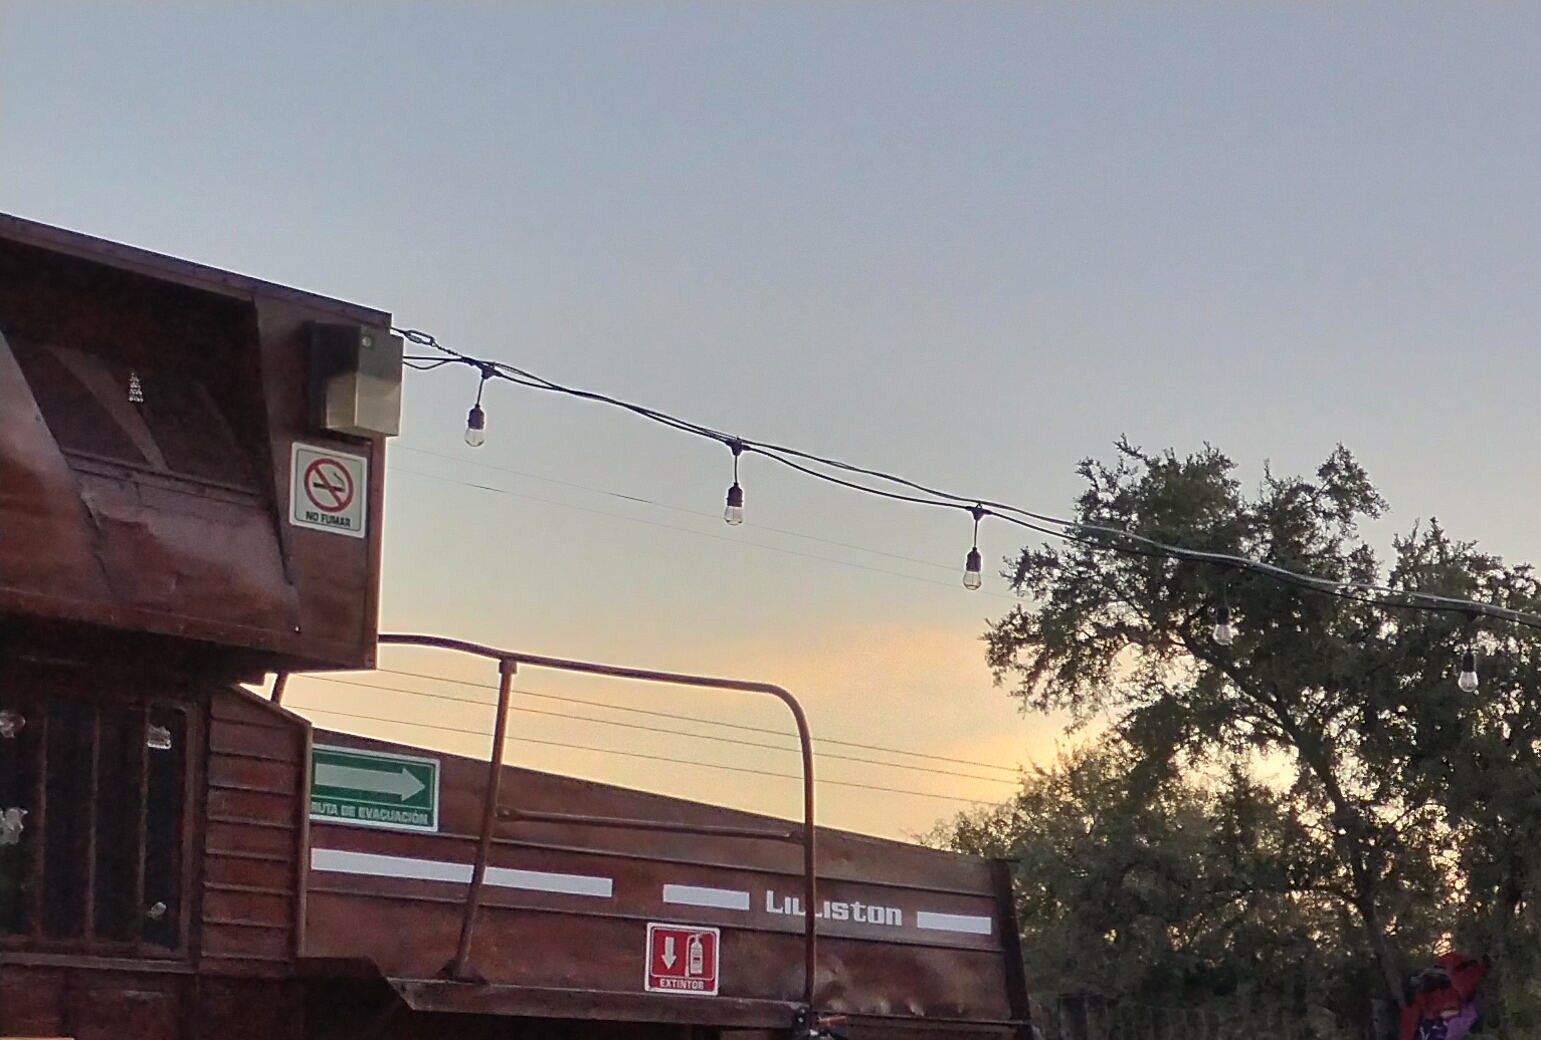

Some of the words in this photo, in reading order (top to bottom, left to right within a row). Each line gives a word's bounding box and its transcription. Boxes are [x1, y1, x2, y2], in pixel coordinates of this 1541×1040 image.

[306, 511, 319, 521] NO
[321, 514, 351, 527] FUMAR
[311, 801, 338, 816] RUTA
[341, 804, 356, 817] DE
[660, 978, 704, 990] EXTINTOR
